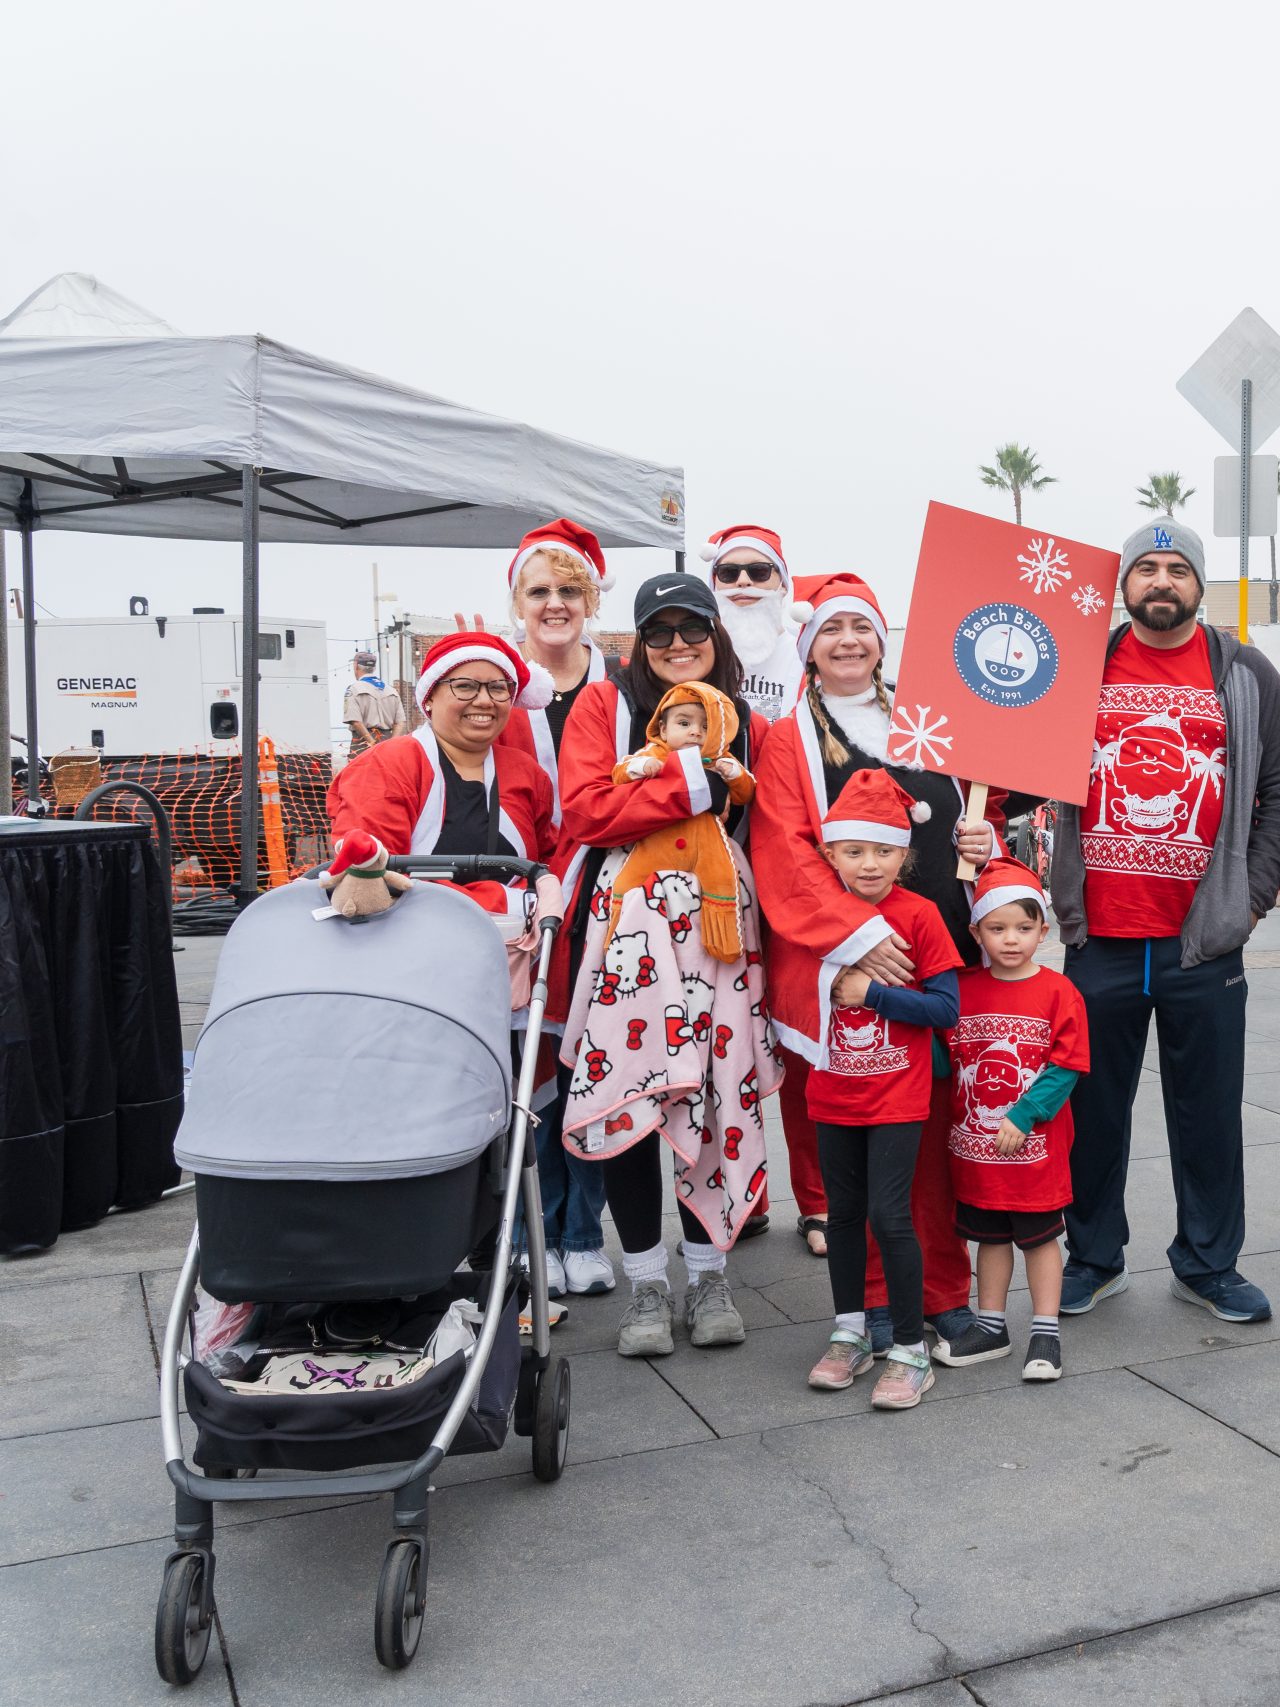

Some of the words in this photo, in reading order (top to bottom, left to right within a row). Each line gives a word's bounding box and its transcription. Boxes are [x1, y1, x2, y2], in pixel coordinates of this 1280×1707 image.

[1154, 528, 1172, 548] LA
[962, 607, 1008, 641] Beach
[1013, 611, 1050, 660] Babies
[57, 677, 137, 690] GENERAC
[981, 682, 997, 697] Est.
[1001, 691, 1022, 700] 1991
